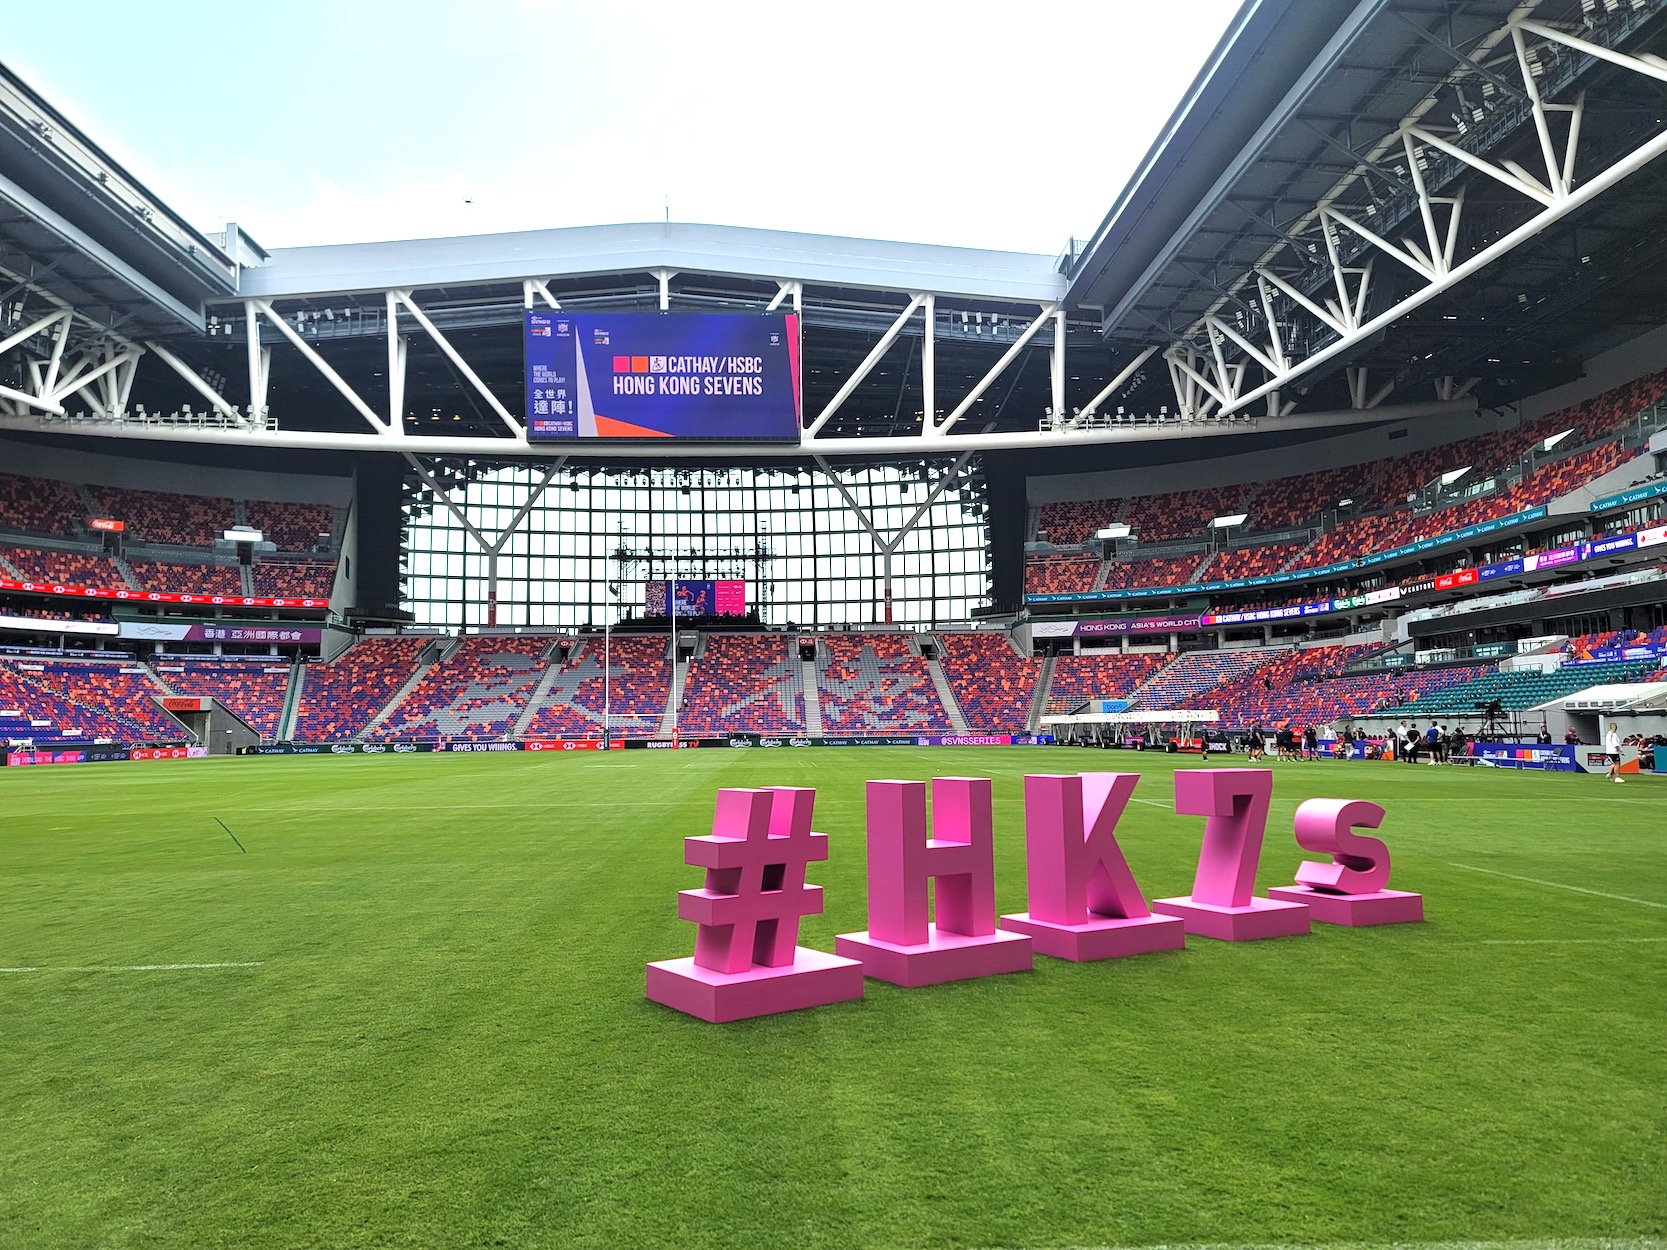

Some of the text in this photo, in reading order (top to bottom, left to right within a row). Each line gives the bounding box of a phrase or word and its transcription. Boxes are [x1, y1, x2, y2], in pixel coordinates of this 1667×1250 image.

[668, 356, 762, 373] CATHAY/HSBC
[613, 376, 763, 395] HONG KONG SEVENS
[533, 389, 566, 399] 全世界
[1628, 492, 1648, 502] CATHAY
[1599, 500, 1618, 510] CATHAY
[1408, 582, 1435, 593] CASTORE
[1080, 624, 1103, 632] HONG
[1156, 620, 1183, 628] WORLD
[204, 628, 302, 640] 香港 亞洲國際都會
[941, 736, 1001, 745] @SVNSSERIES
[452, 744, 472, 752] GIVES
